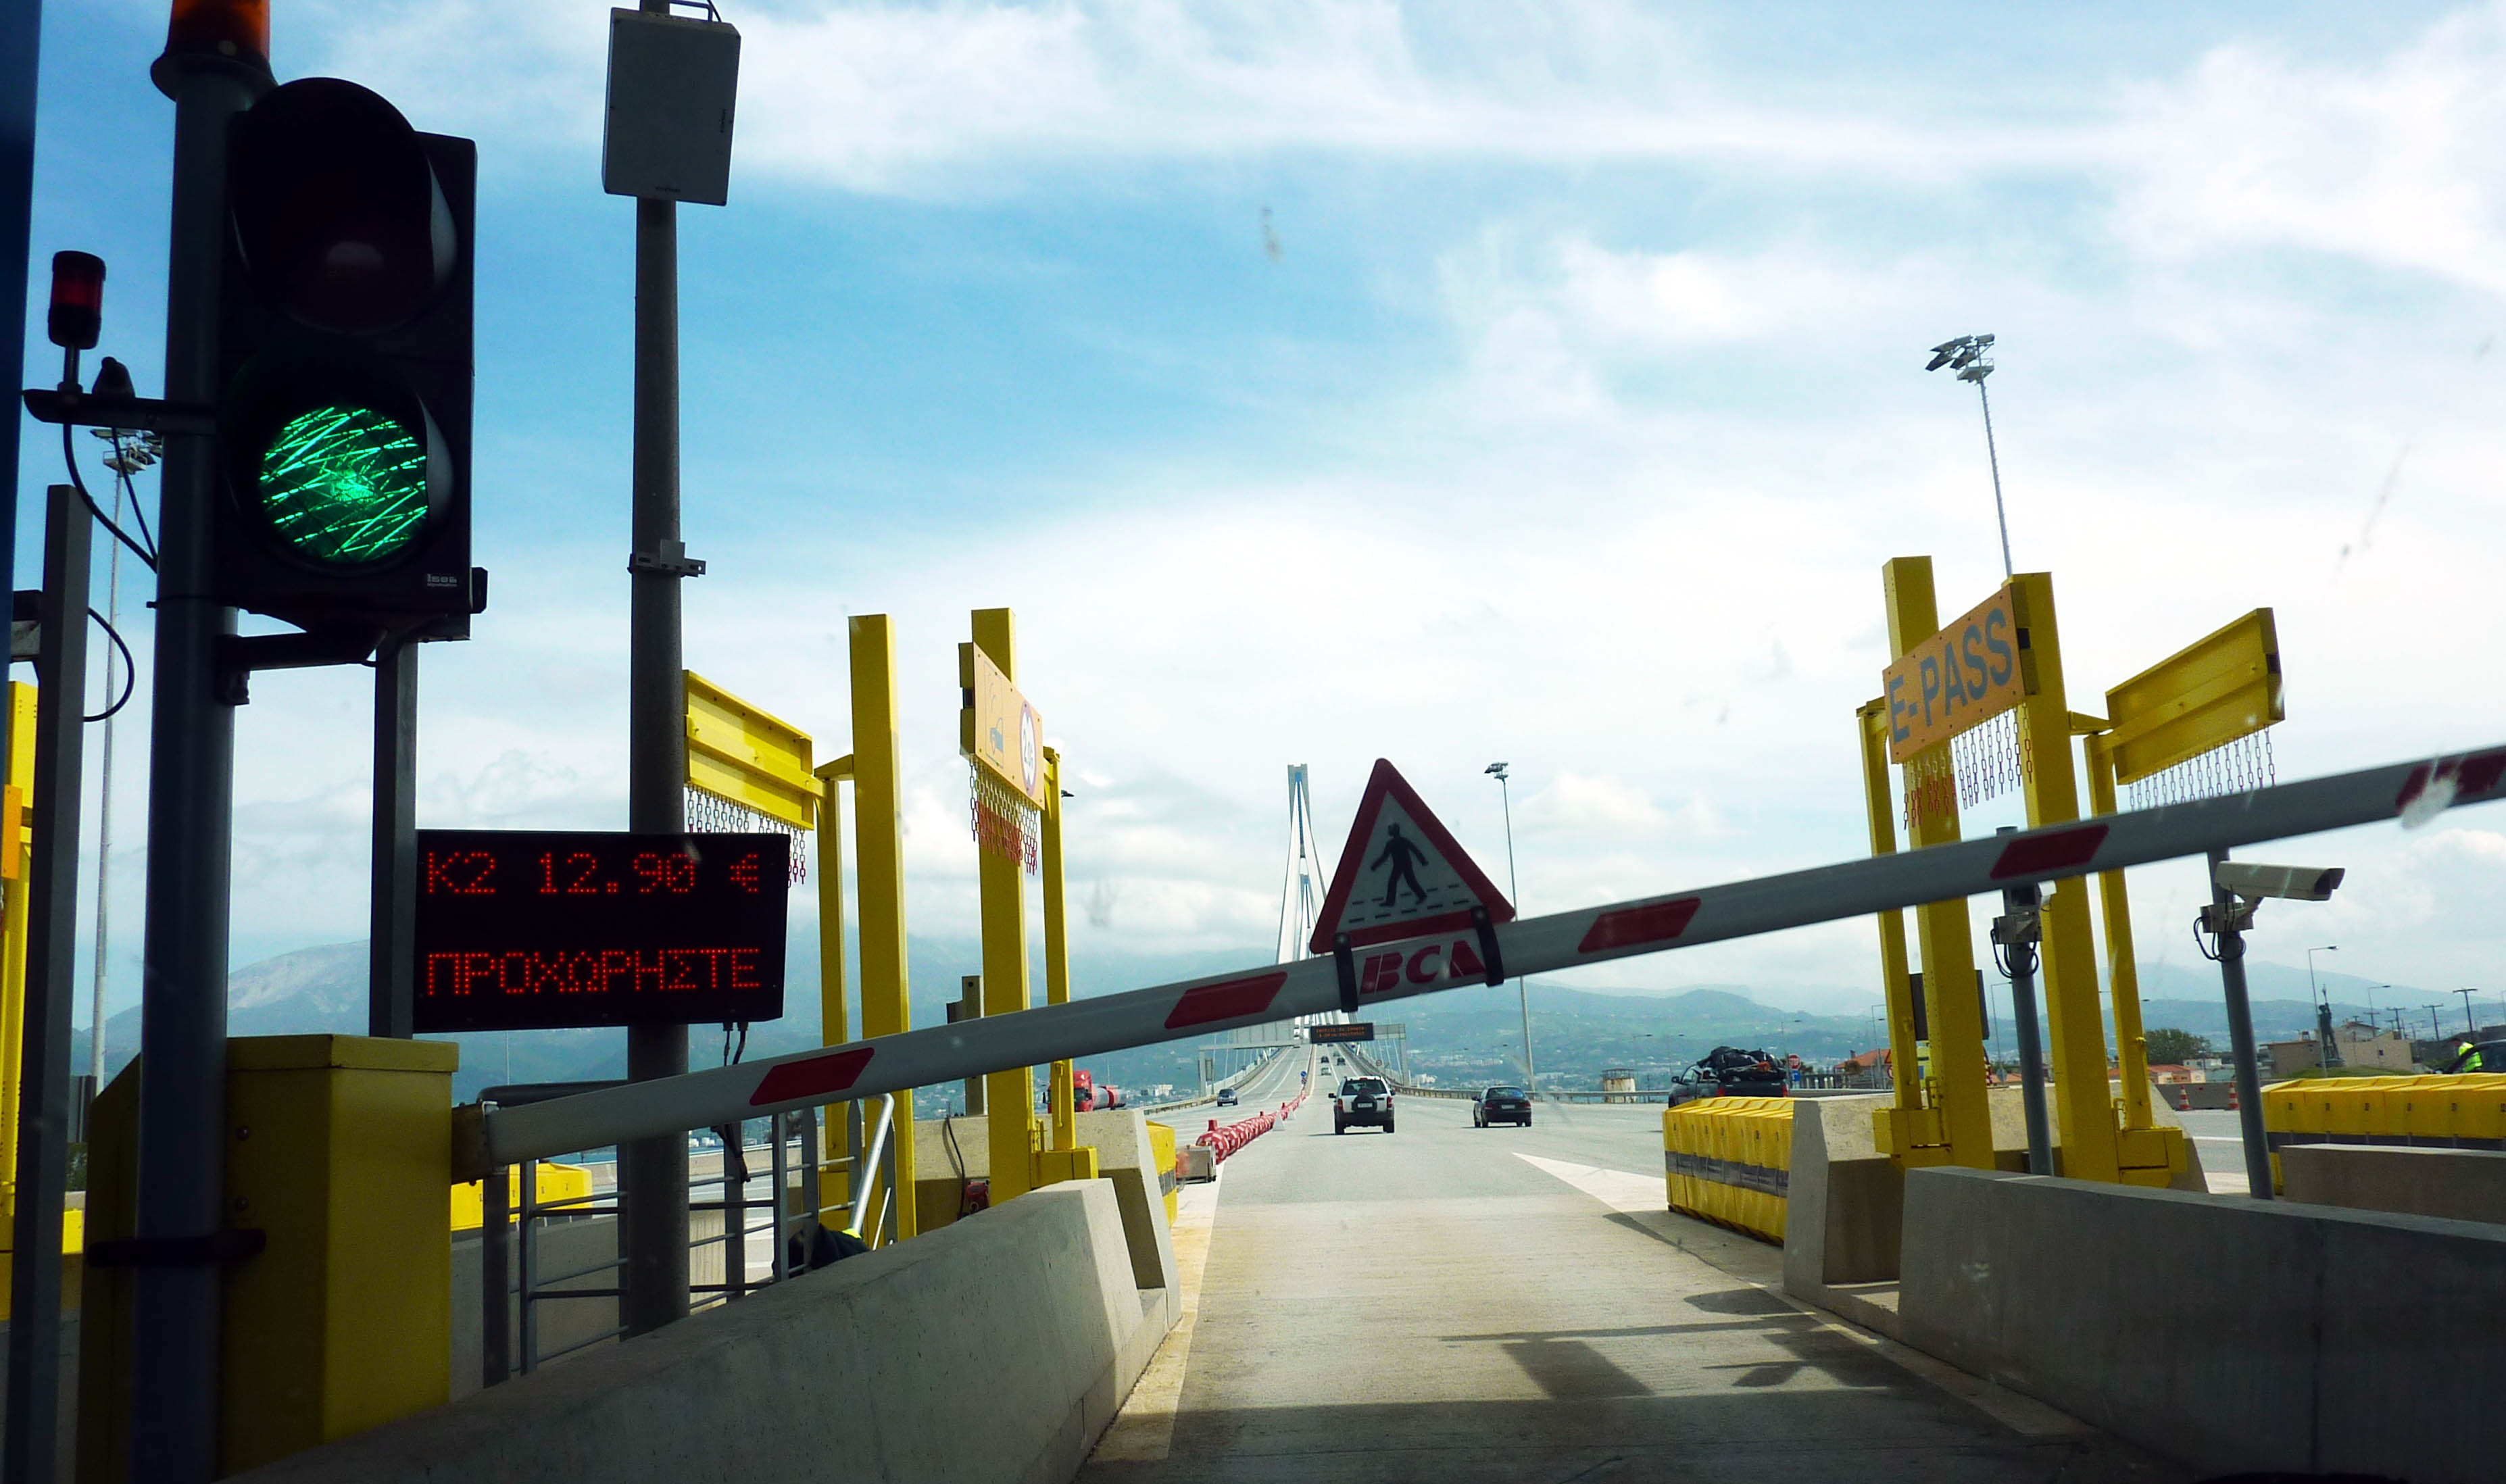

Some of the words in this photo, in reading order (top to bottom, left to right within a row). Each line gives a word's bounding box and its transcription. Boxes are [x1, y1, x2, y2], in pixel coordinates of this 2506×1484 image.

[1888, 608, 2012, 743] E-PASS
[427, 852, 496, 893] K2
[540, 852, 696, 893] 12.90
[730, 854, 758, 893] €
[427, 948, 761, 996] ΠΡΟΧΩΡΗΣΤΕ
